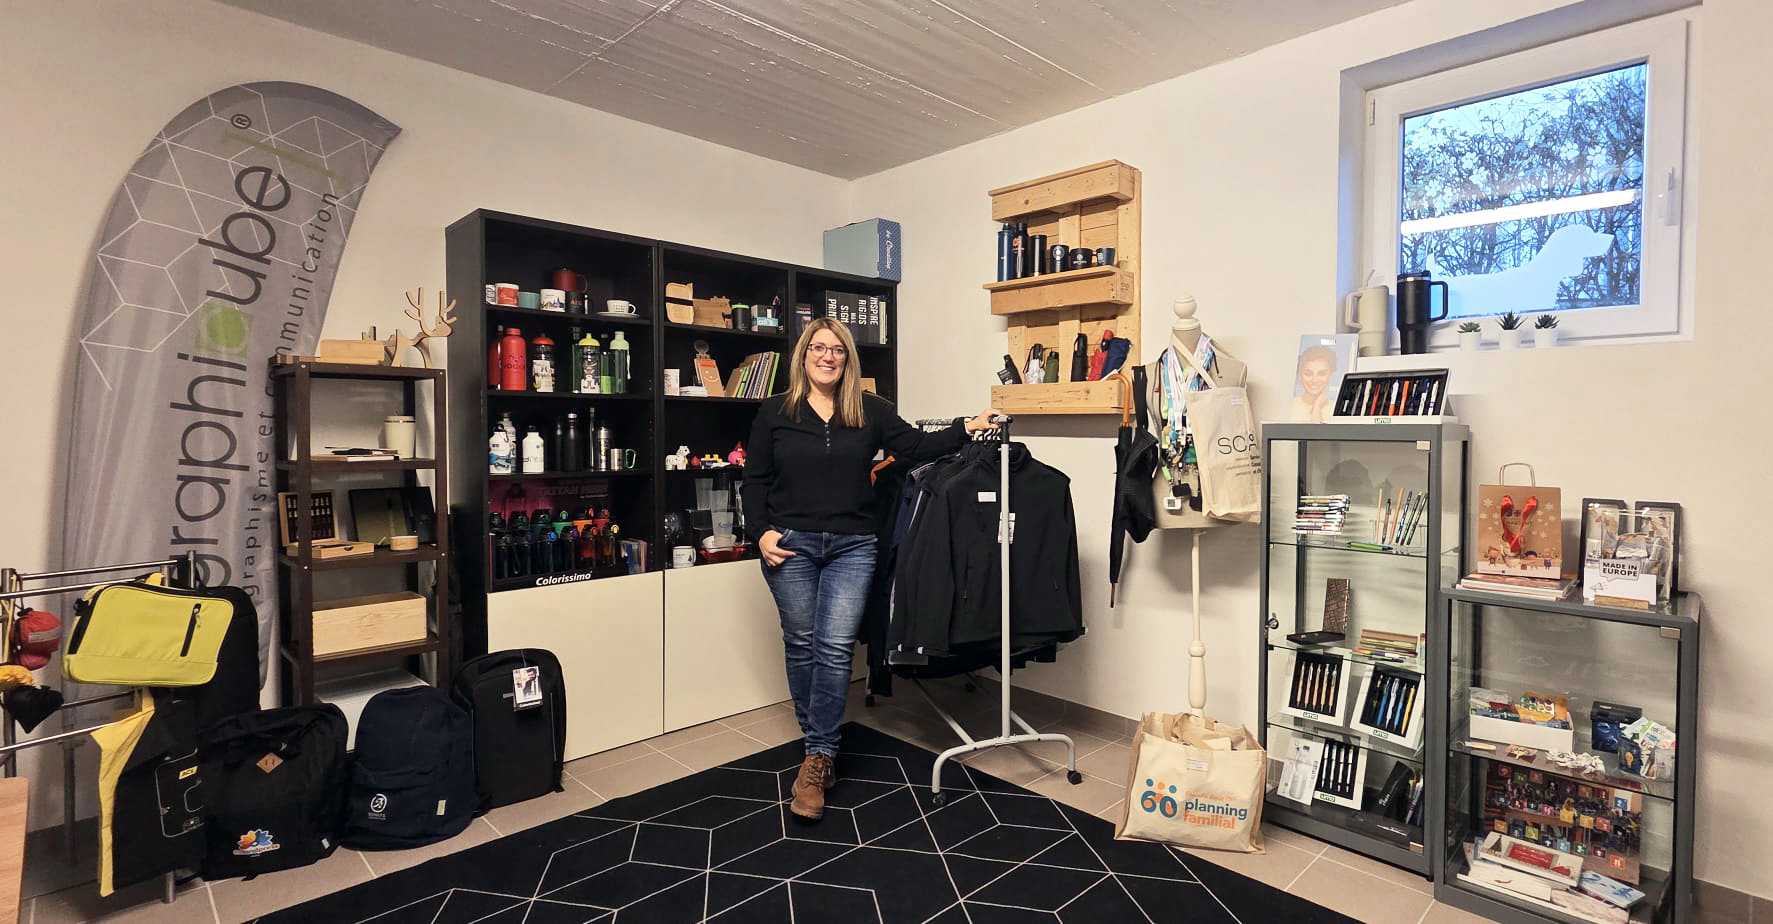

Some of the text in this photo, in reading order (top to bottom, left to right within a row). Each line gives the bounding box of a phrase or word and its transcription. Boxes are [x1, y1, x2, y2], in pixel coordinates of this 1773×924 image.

[242, 451, 269, 598] graphisme
[535, 572, 592, 586] Colorissimo
[1603, 568, 1638, 577] EUROPE
[1184, 798, 1248, 821] planning
[1183, 810, 1236, 830] familial
